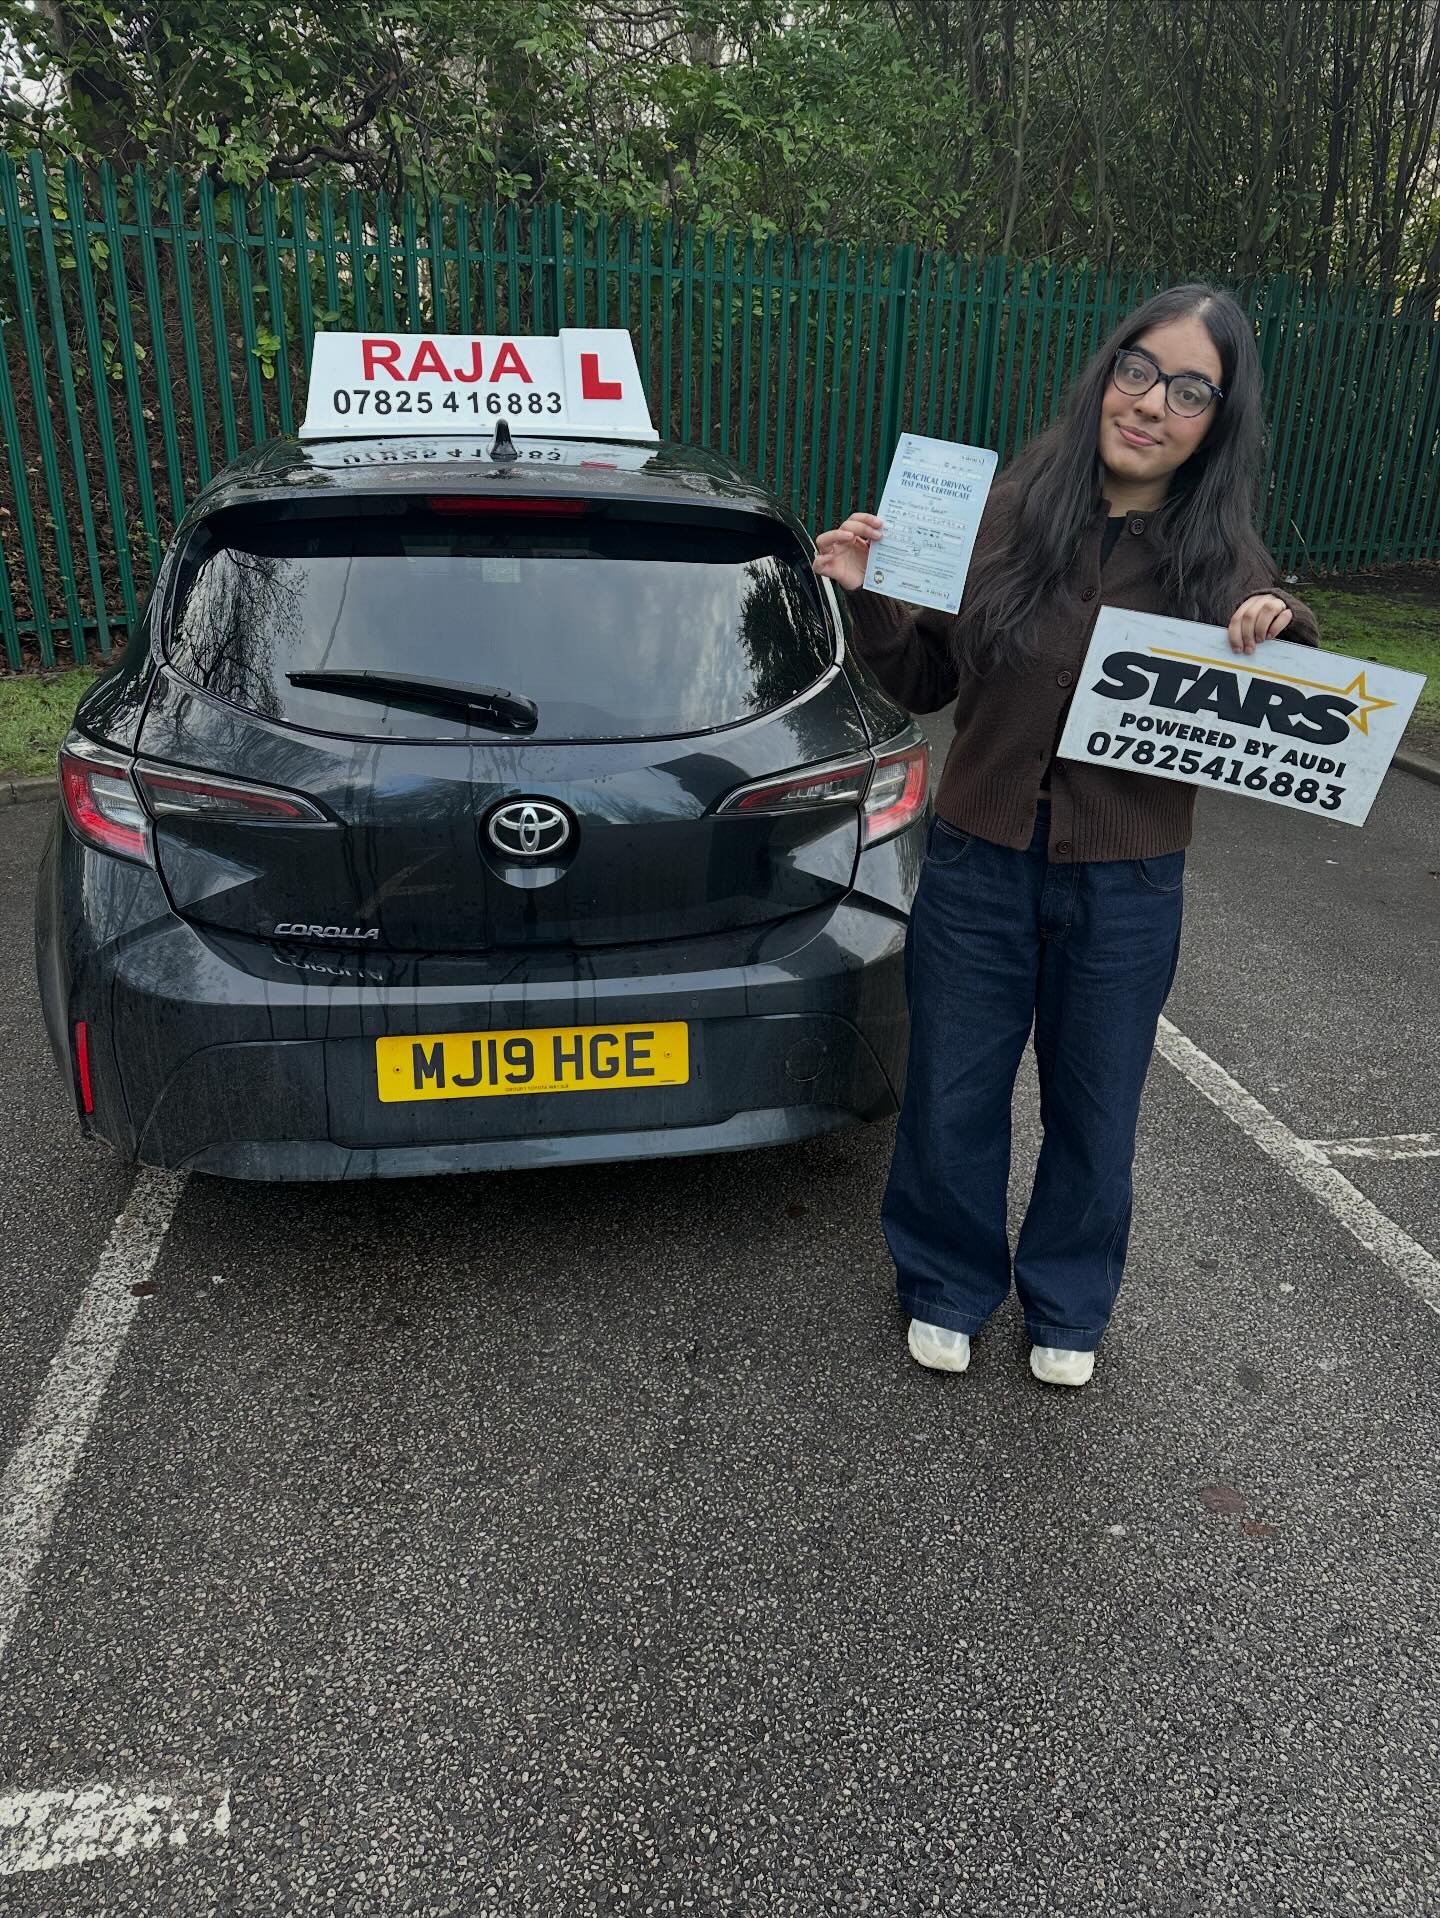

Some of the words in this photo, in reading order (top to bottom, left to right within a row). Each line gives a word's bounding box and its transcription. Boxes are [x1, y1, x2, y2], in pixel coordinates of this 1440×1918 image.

[362, 339, 533, 383] RAJA
[580, 353, 622, 400] L
[901, 479, 915, 487] TEST
[915, 482, 930, 491] PASS
[931, 485, 971, 501] CERTIFICATE
[902, 470, 939, 485] PRACTICAL
[940, 479, 973, 493] DRIVING
[1091, 651, 1359, 746] STARS
[1120, 712, 1237, 749] POWERED
[1244, 738, 1278, 759] BY
[1282, 749, 1347, 778] AUDI
[1086, 731, 1347, 811] 07825416883
[274, 923, 380, 940] COROLLA
[411, 1037, 535, 1090] MJ19
[552, 1031, 655, 1082] HGE
